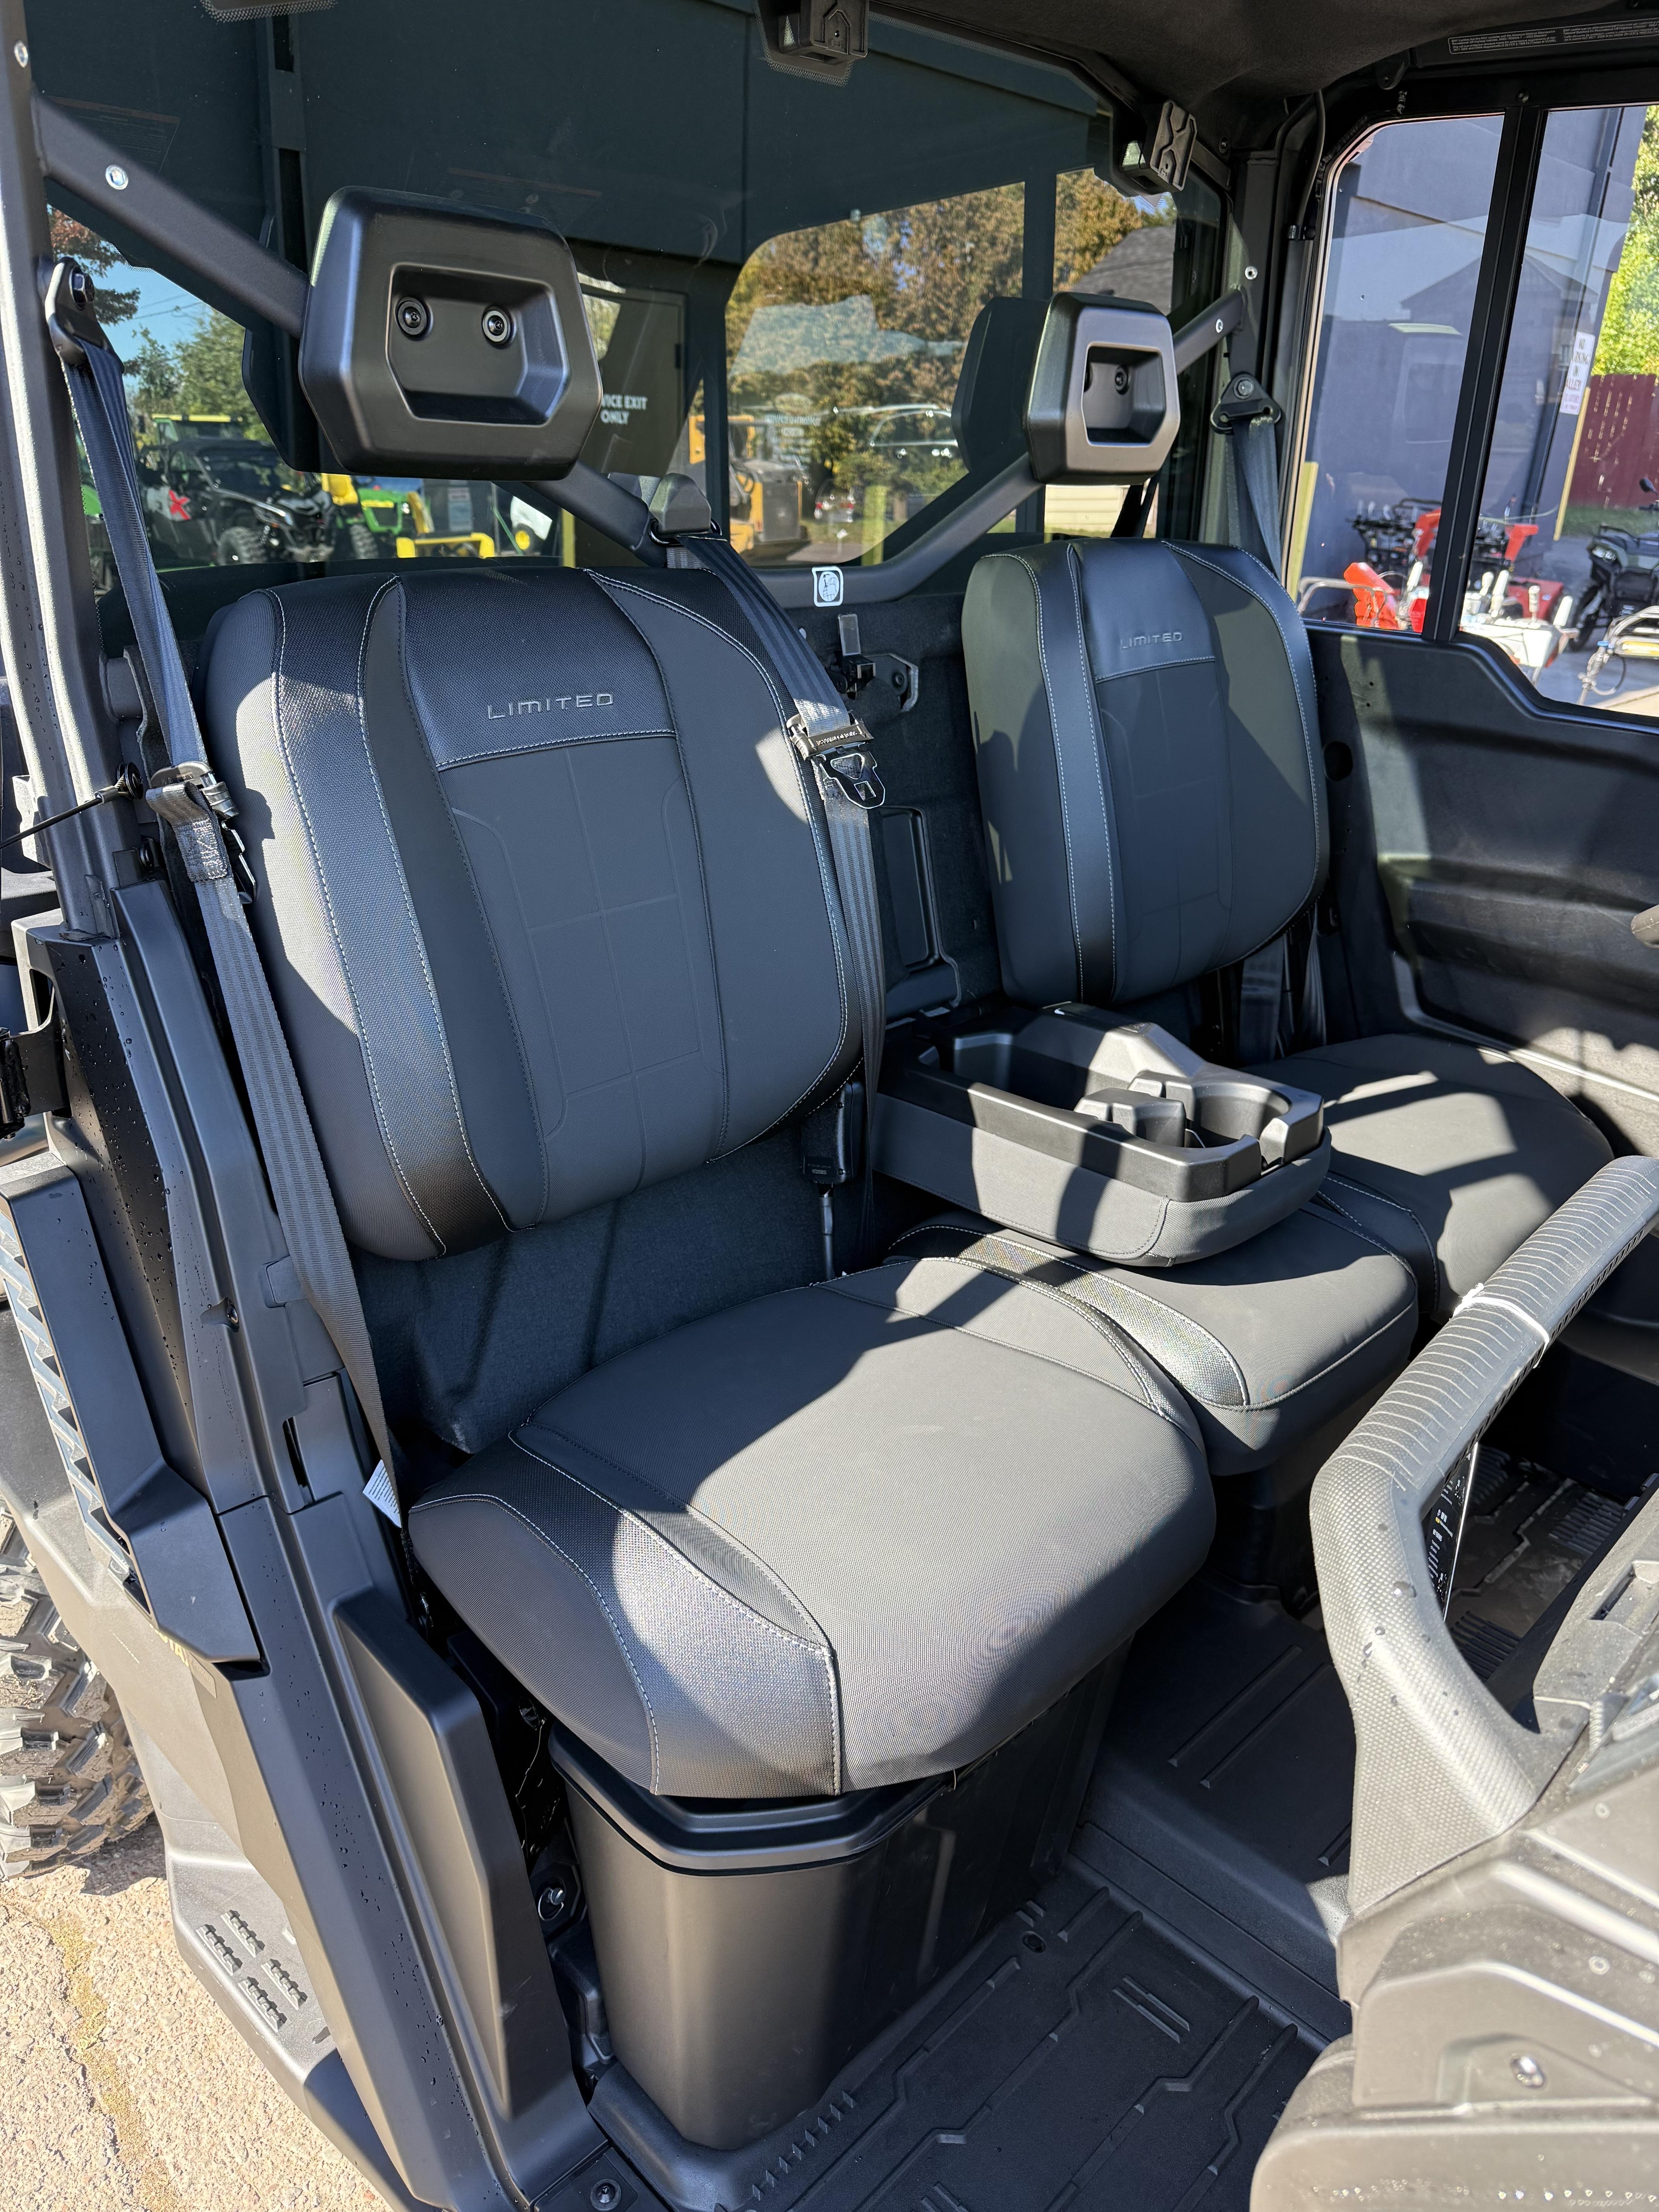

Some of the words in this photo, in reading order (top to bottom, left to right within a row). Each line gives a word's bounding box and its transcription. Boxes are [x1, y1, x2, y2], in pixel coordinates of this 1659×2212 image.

[624, 395, 648, 410] EXIT
[600, 410, 629, 425] ONLY
[1120, 632, 1182, 649] LIMITED
[488, 694, 613, 720] LIMITED
